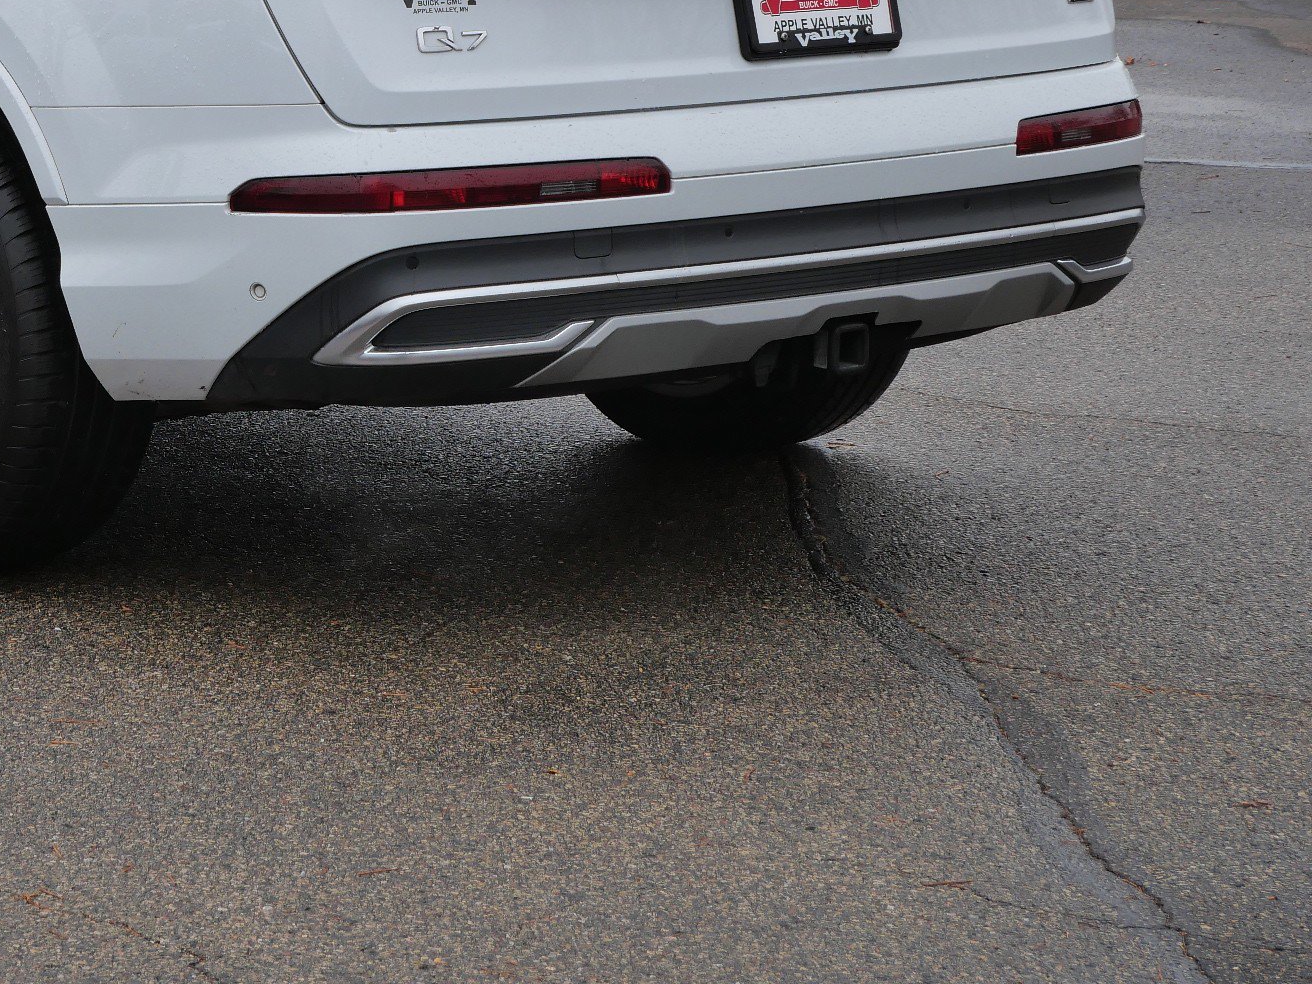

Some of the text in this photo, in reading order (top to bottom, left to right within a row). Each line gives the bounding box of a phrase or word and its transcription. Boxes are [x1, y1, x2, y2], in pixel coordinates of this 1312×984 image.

[417, 0, 440, 7] BUICK
[798, 0, 839, 9] BUICK GMC
[413, 7, 434, 15] APPLE
[774, 18, 808, 32] APPLE
[856, 13, 874, 26] MN
[416, 25, 488, 54] Q7
[795, 28, 859, 47] Valley
